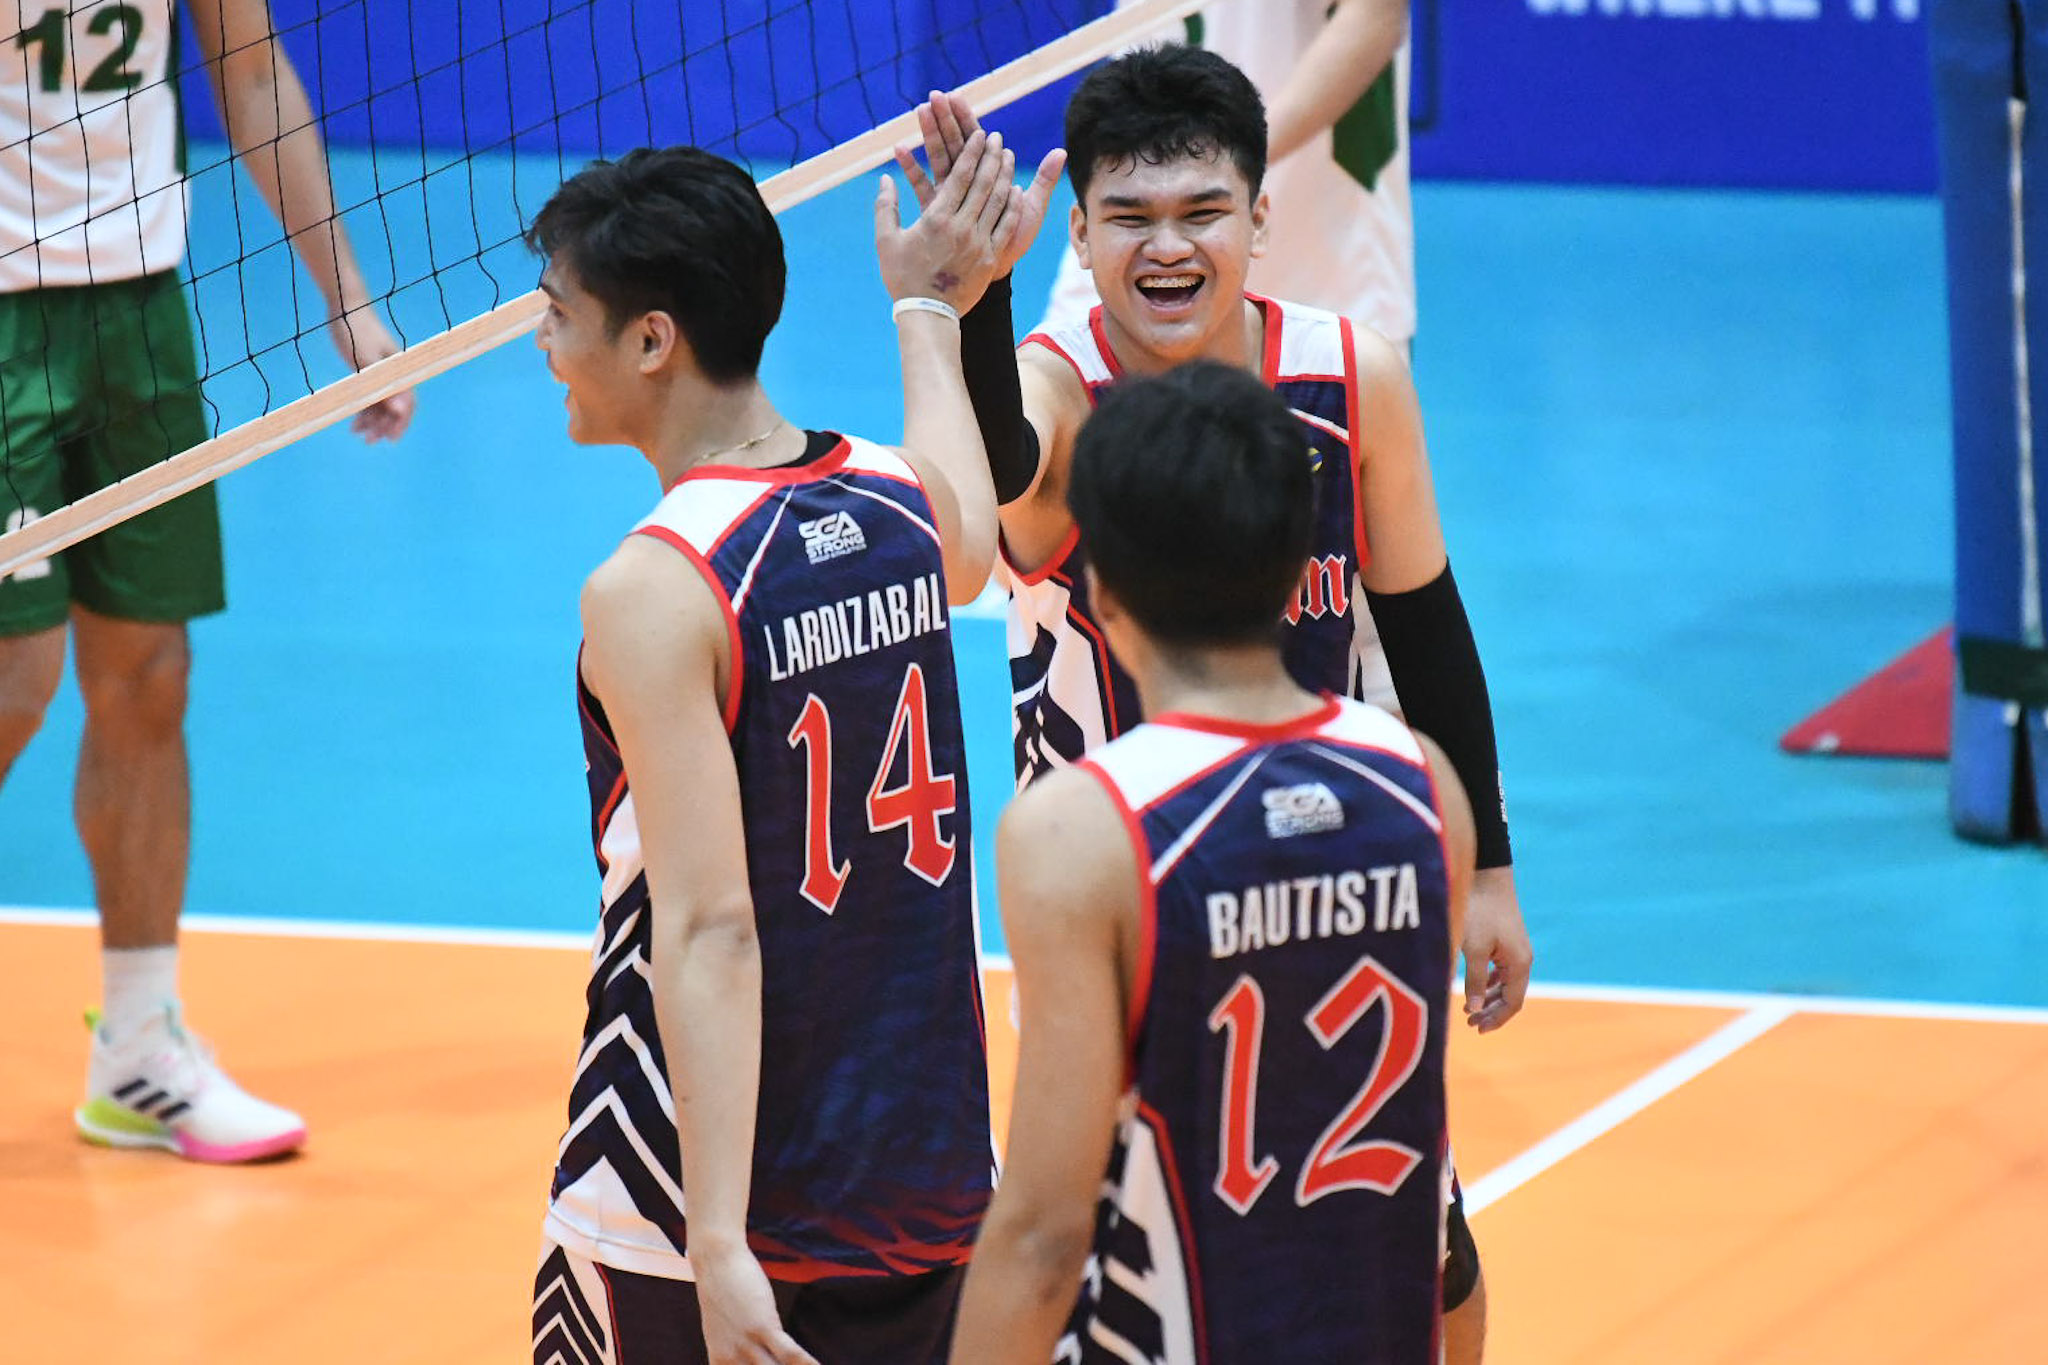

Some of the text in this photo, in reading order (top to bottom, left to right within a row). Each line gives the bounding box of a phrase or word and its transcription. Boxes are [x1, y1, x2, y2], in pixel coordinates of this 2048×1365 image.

[16, 5, 144, 93] 12
[798, 510, 861, 541] SGA
[805, 533, 866, 559] STRONG
[764, 572, 946, 681] LARDIZABAL
[787, 662, 956, 915] 14
[1207, 863, 1420, 959] BAUTISTA
[1208, 954, 1429, 1216] 12
